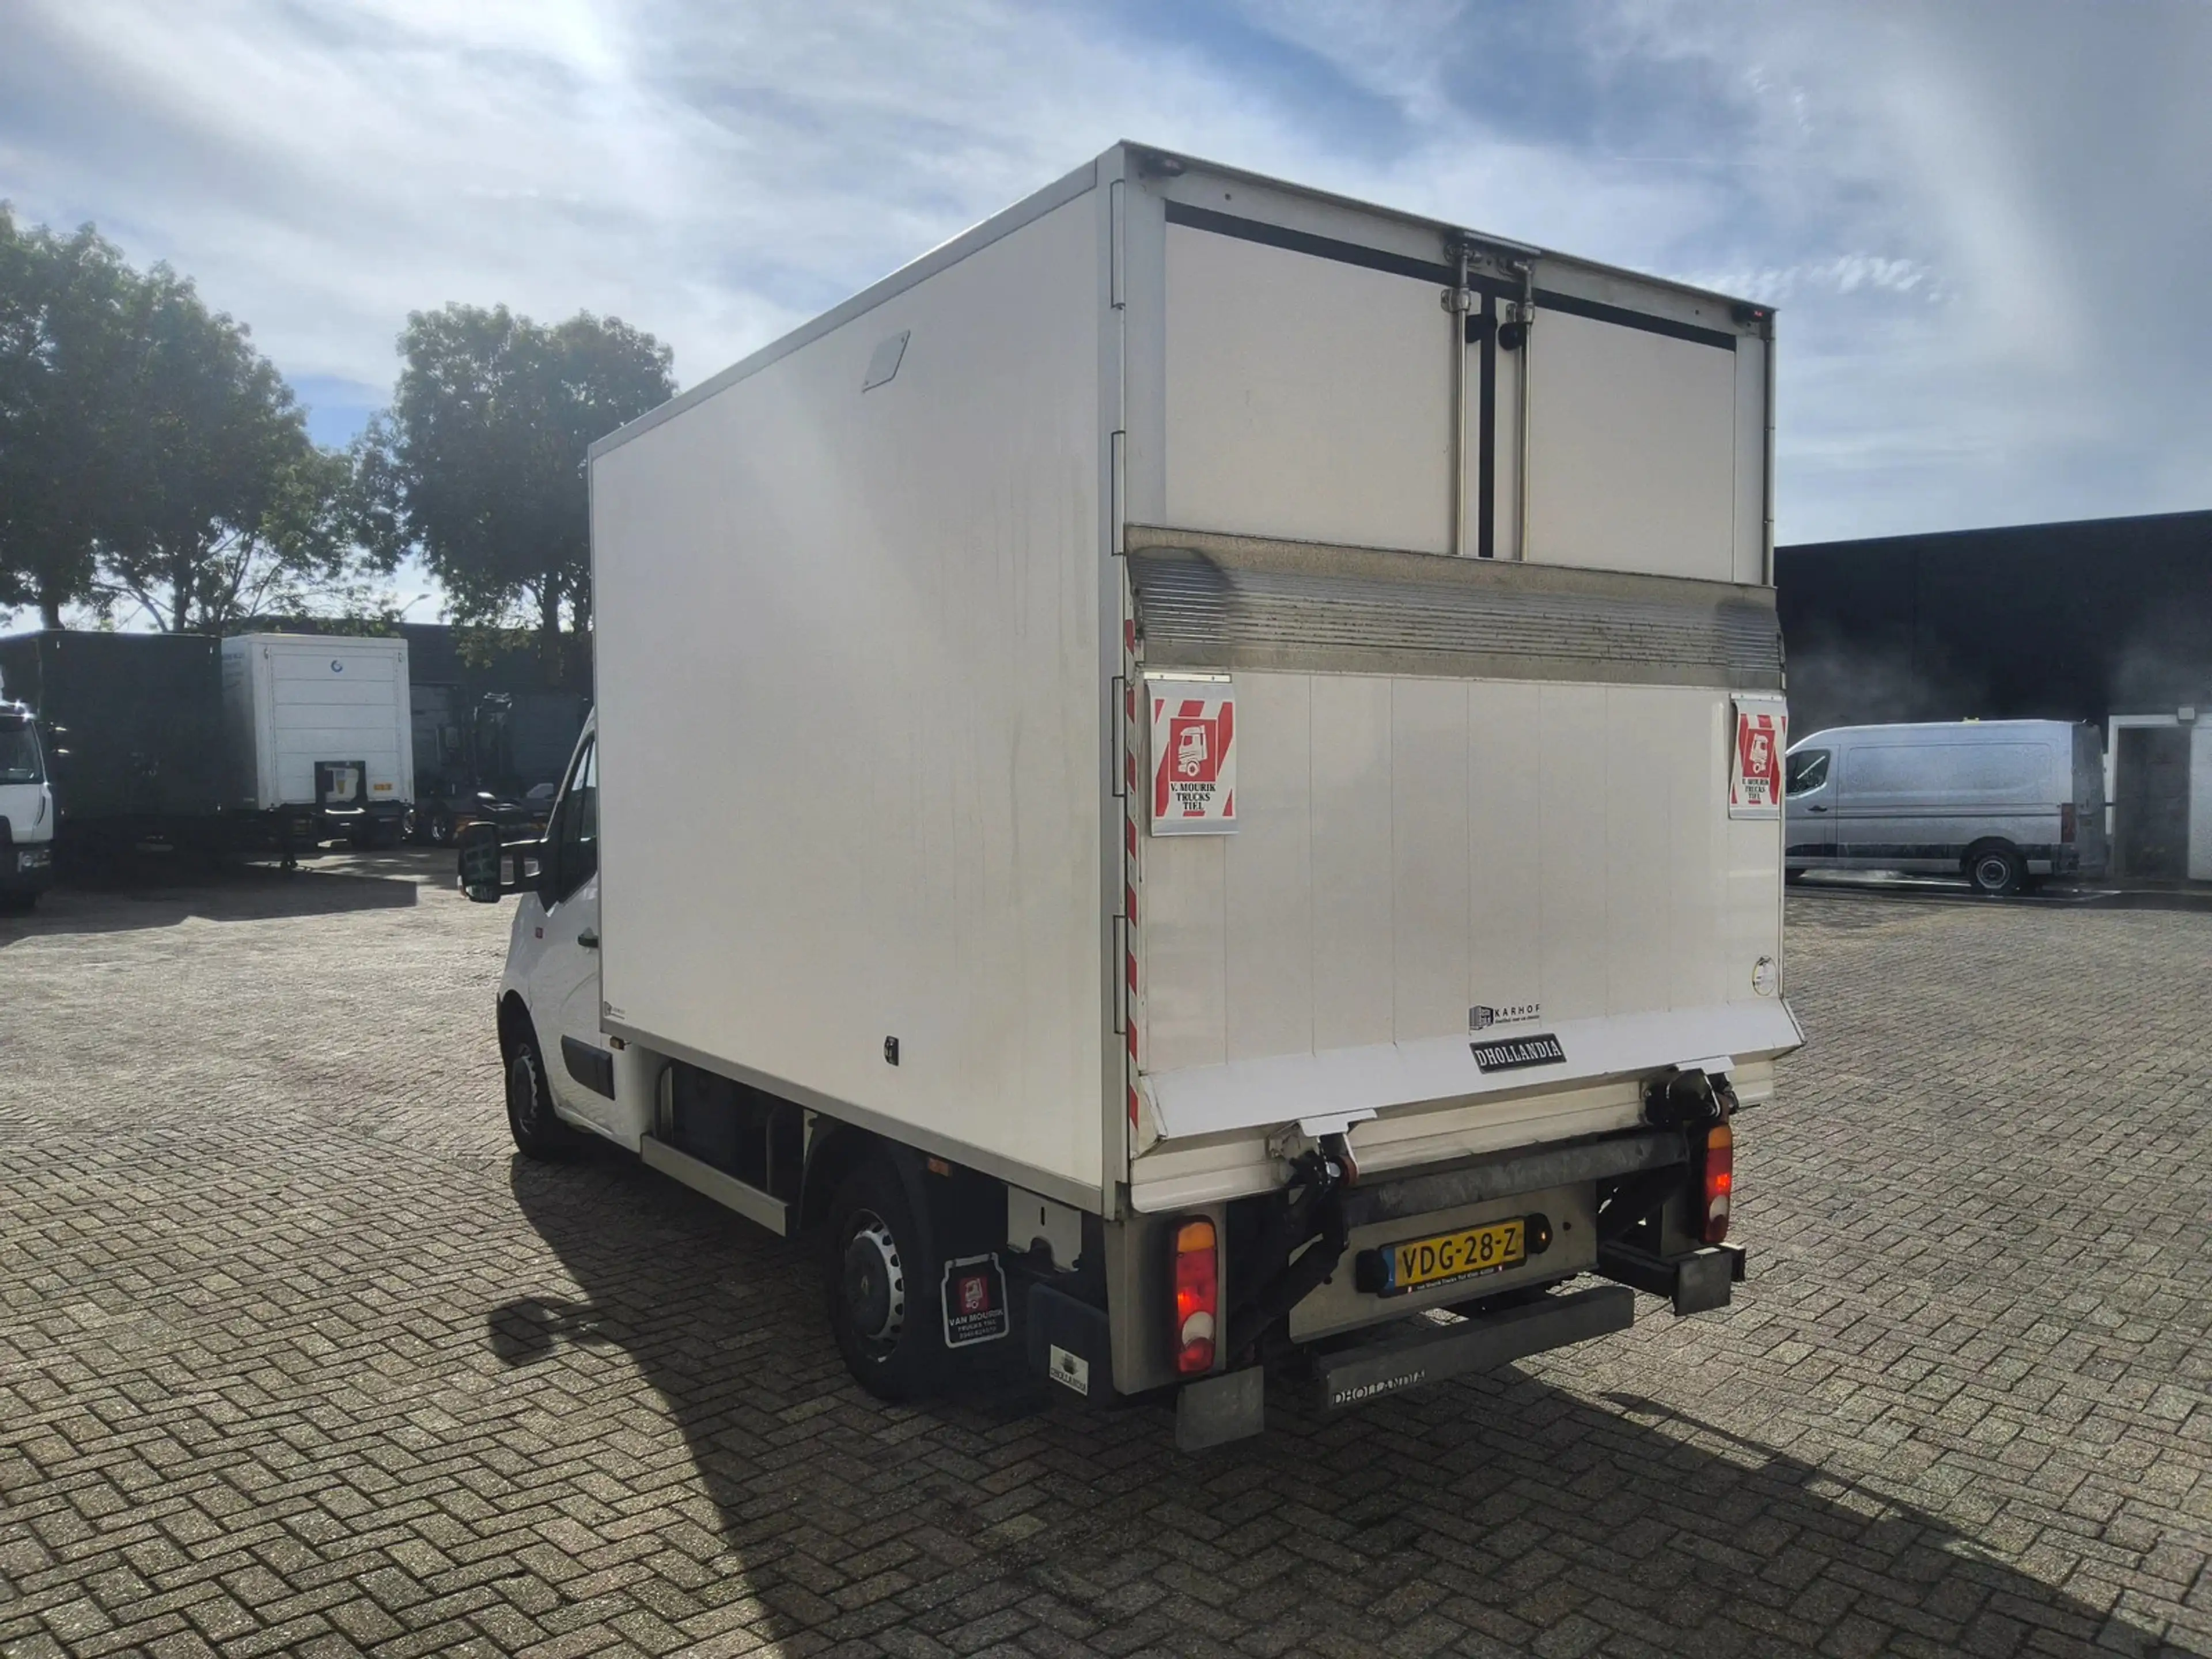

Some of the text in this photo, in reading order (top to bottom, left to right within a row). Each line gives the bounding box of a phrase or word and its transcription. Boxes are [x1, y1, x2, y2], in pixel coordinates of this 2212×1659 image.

[1171, 783, 1216, 791] V. MOURIK
[1176, 792, 1210, 801] TRUCKS
[1183, 801, 1204, 810] TIEL
[1495, 1003, 1540, 1018] KARHOF
[1475, 1040, 1562, 1066] DHOLLANDIA
[1402, 1227, 1517, 1279] VDG-28-Z
[949, 1316, 967, 1327] VAN
